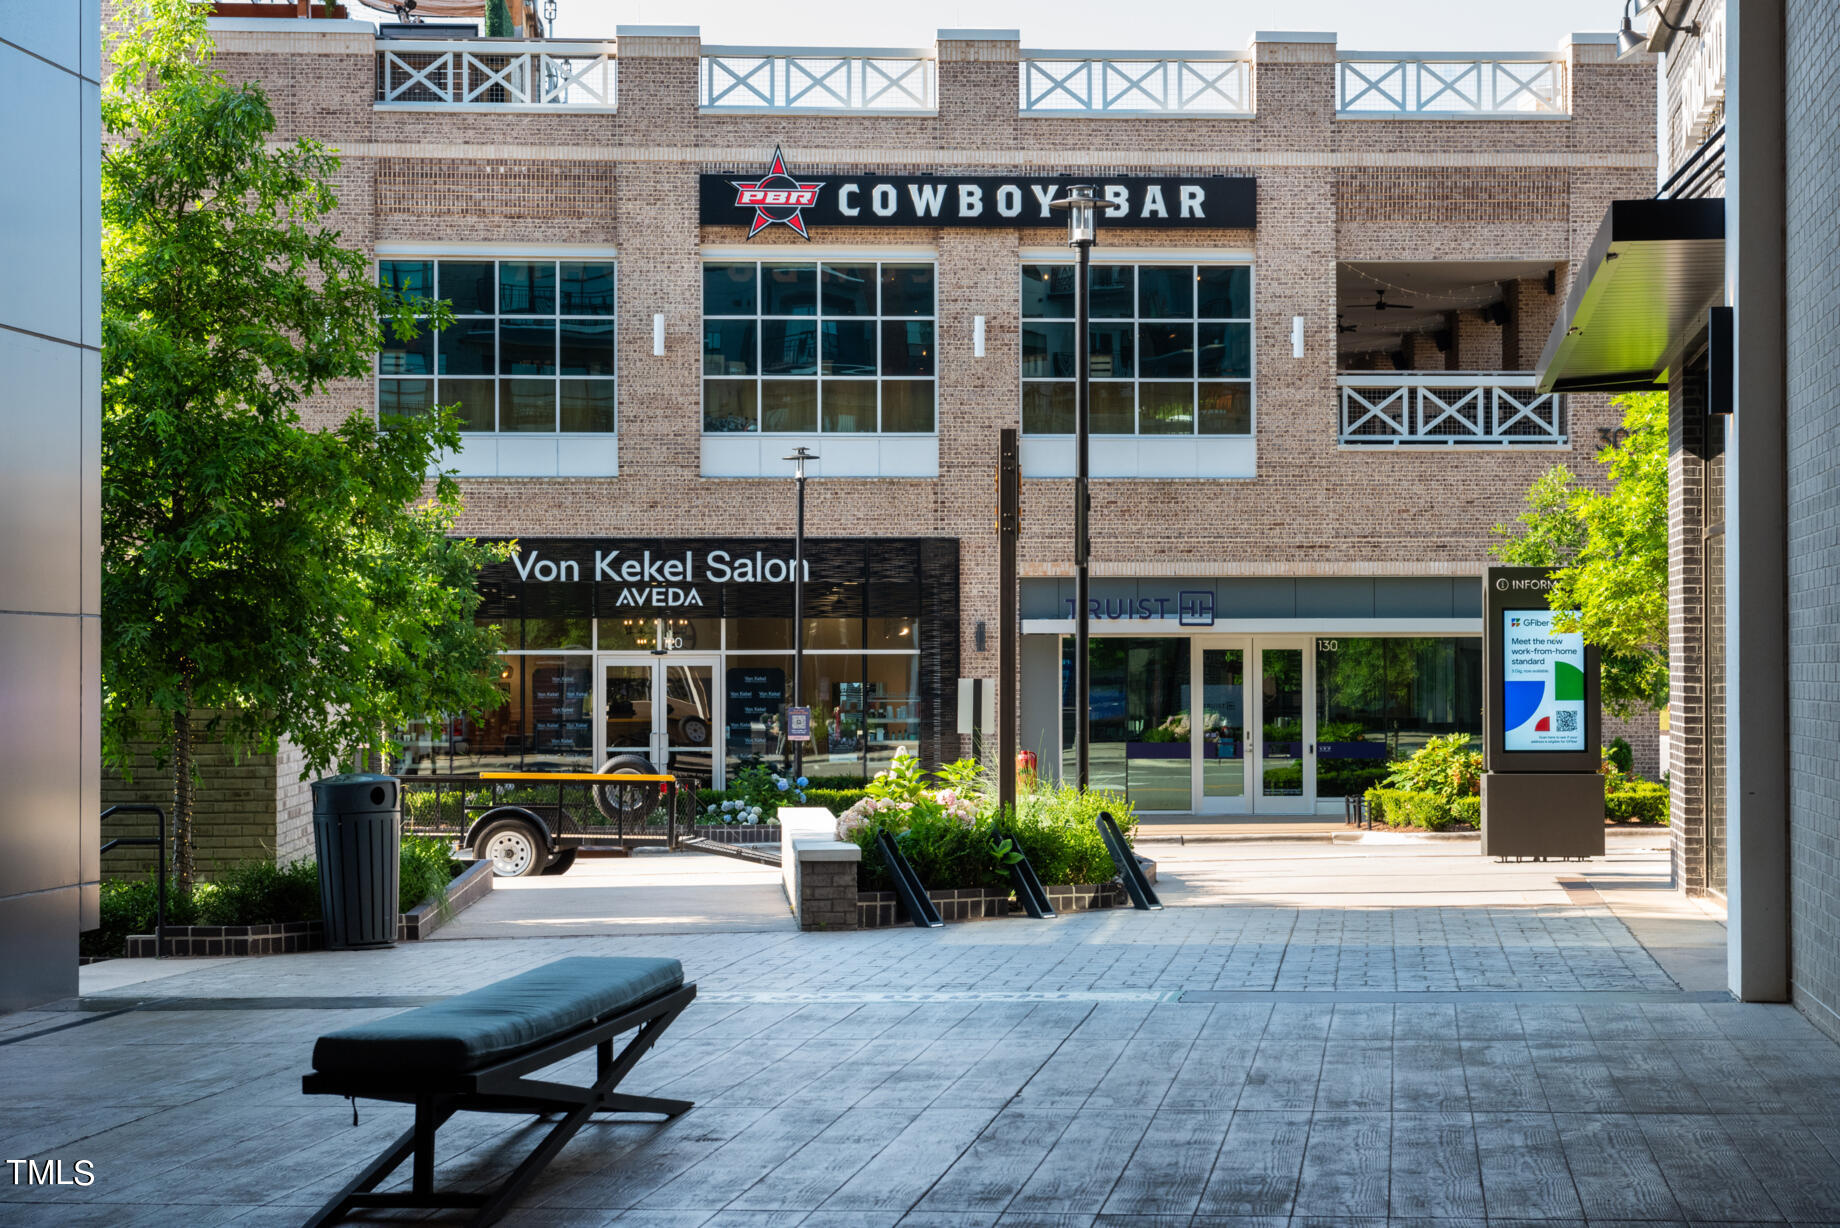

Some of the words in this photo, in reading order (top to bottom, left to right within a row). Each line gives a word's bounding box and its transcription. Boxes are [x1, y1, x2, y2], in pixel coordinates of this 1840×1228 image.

[741, 191, 813, 204] PBR
[838, 183, 1060, 218] COWBOY
[1104, 185, 1206, 219] BAR
[1595, 427, 1638, 452] 30
[510, 550, 579, 582] Von
[595, 550, 693, 582] Kekel
[706, 550, 809, 583] Salon
[1512, 579, 1558, 590] INFORM
[615, 587, 704, 607] AVEDA
[1065, 598, 1170, 620] TRUIST
[1523, 618, 1550, 627] GFiber
[1318, 640, 1338, 652] 130
[1511, 637, 1531, 645] Meet
[1532, 637, 1545, 645] the
[1511, 647, 1578, 655] work-from-home
[1511, 657, 1545, 665] standard
